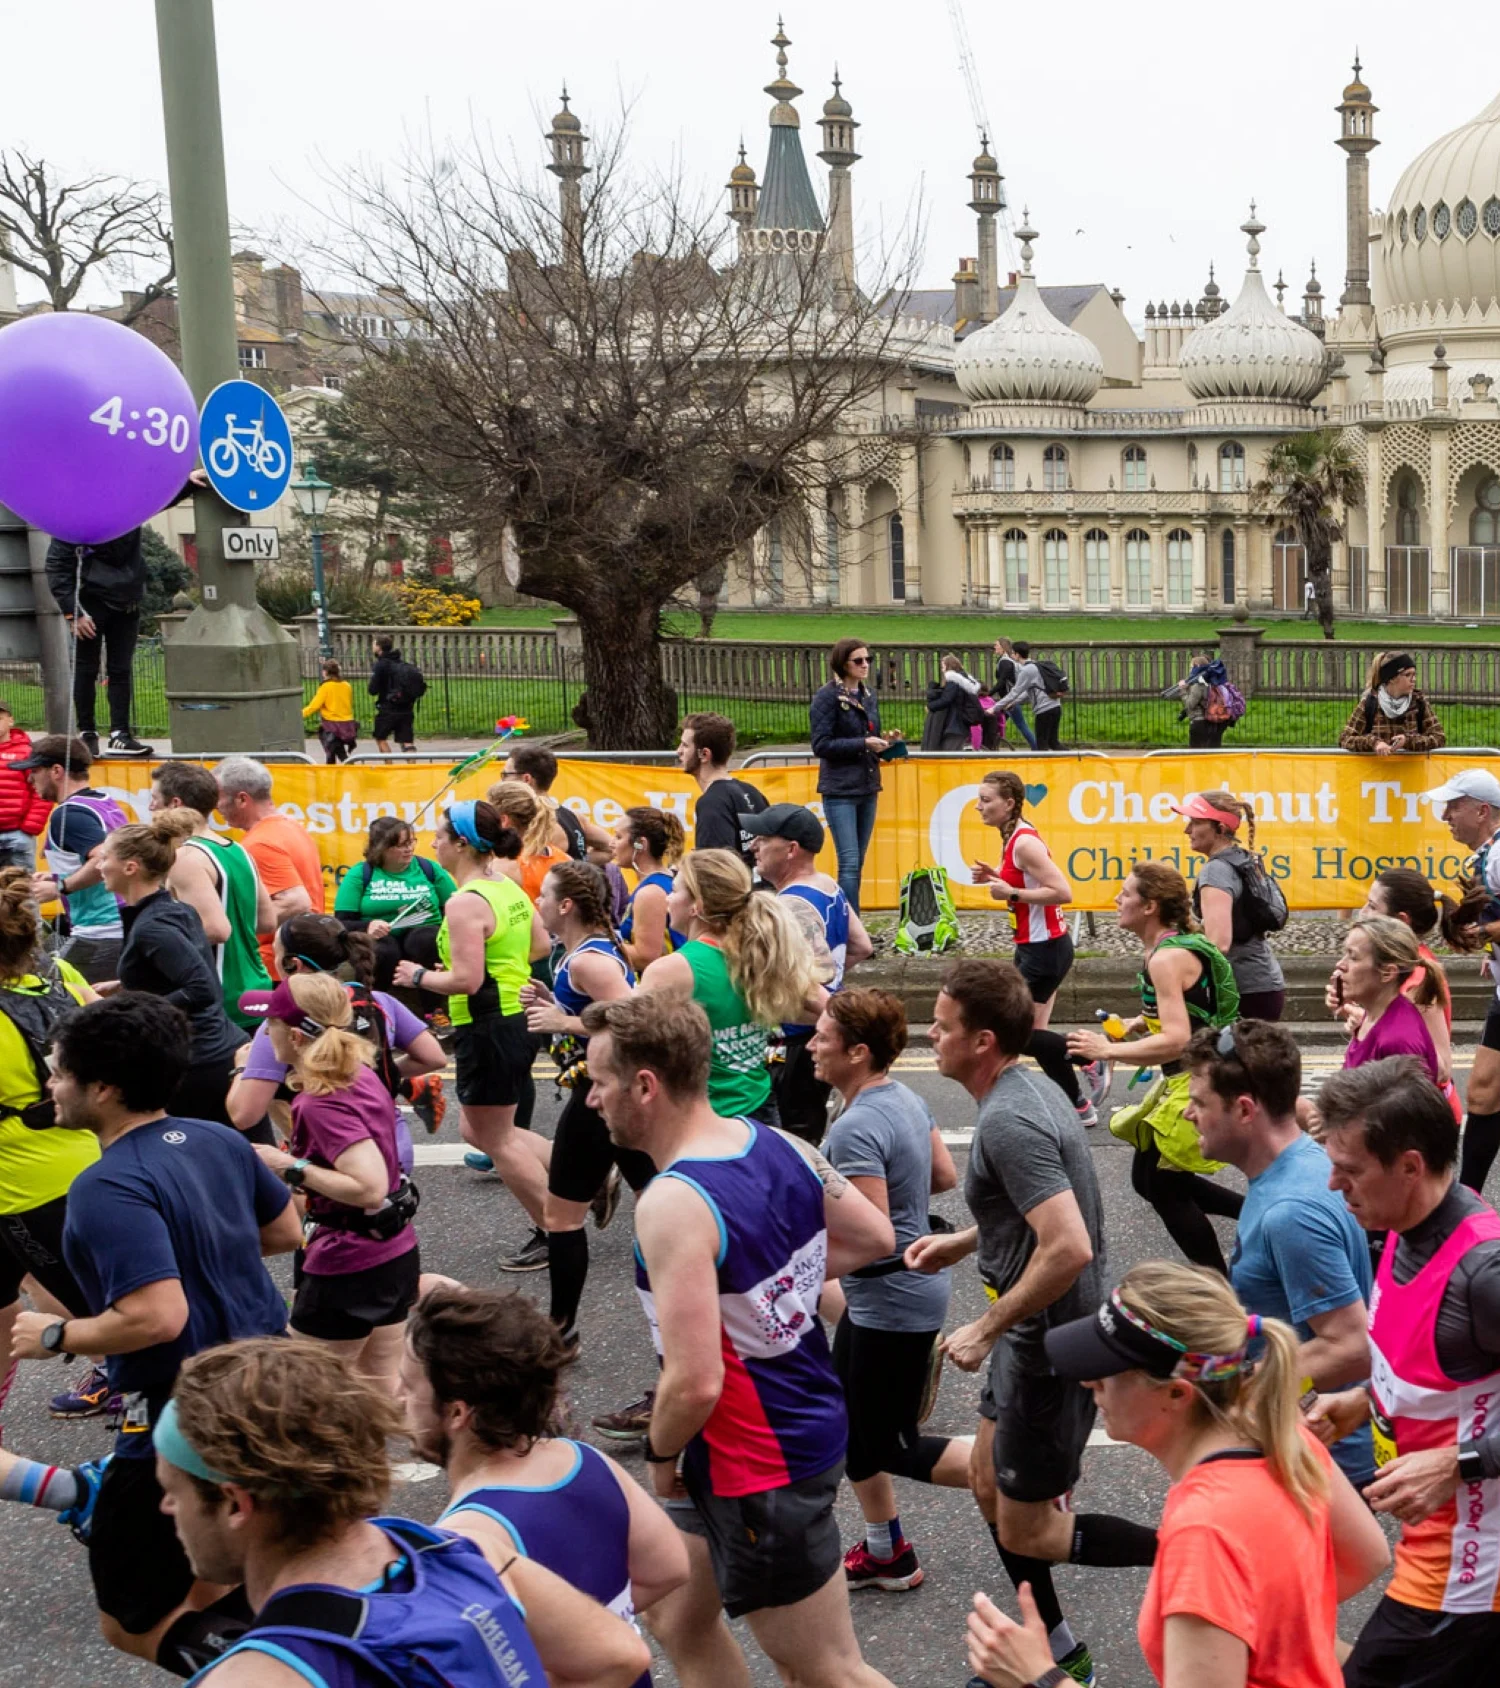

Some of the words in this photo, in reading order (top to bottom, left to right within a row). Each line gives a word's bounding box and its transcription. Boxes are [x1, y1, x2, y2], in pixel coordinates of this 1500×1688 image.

[89, 396, 190, 453] 4:30
[227, 533, 274, 556] Only
[1068, 781, 1339, 826] Chenut
[1361, 781, 1450, 824] Tr
[1471, 1392, 1497, 1440] brea
[1466, 1479, 1485, 1533] ancer
[1459, 1539, 1480, 1585] care
